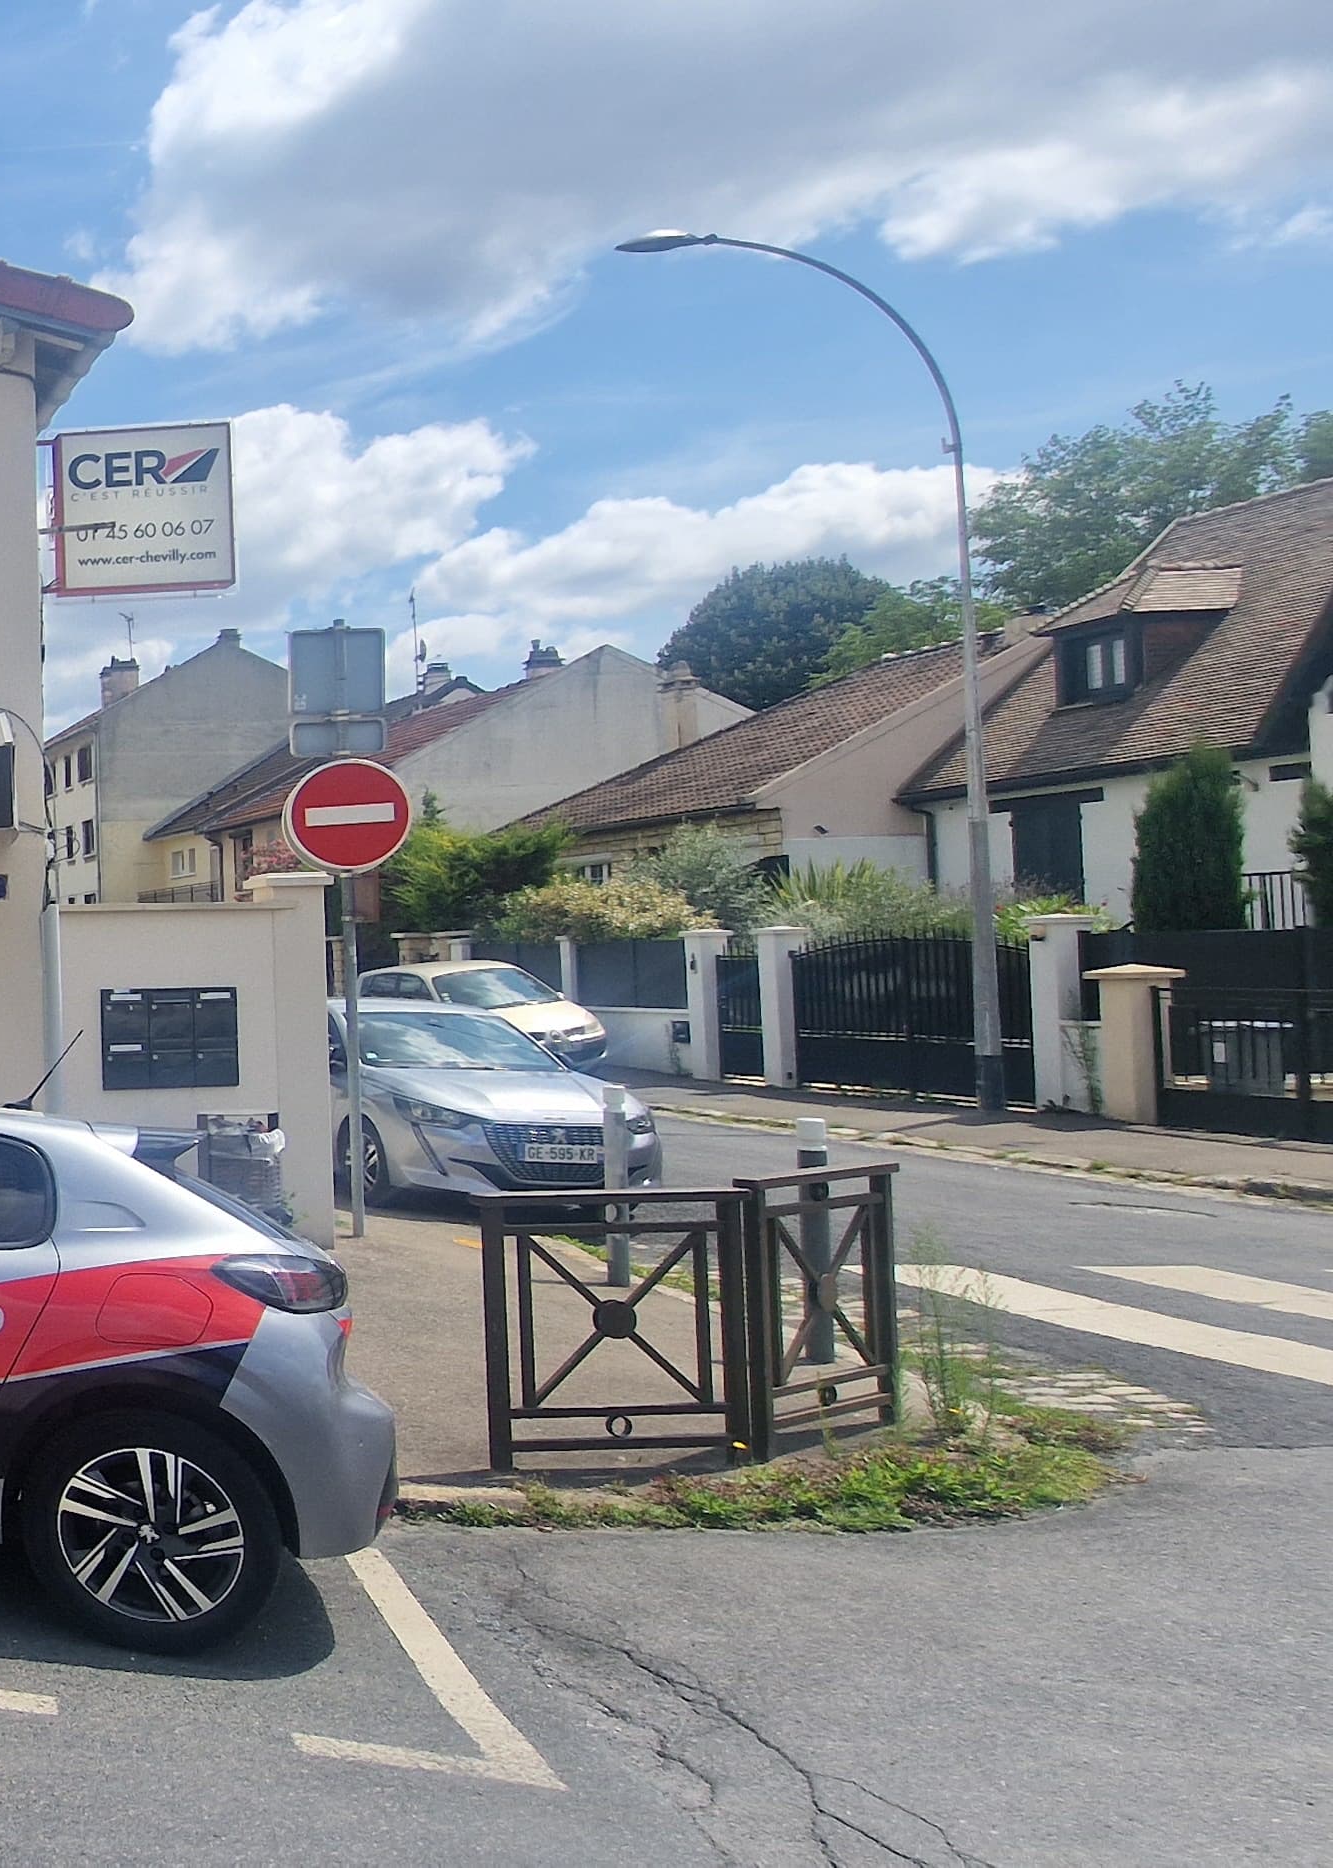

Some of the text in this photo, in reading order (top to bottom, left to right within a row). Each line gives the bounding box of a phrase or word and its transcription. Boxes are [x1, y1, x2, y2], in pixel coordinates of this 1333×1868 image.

[68, 450, 167, 490] CER
[71, 490, 121, 502] C'EST
[105, 524, 128, 540] 45
[133, 522, 156, 539] 60
[161, 521, 185, 537] 06
[191, 519, 215, 535] 07
[78, 548, 216, 567] www.cer-chevilly.com
